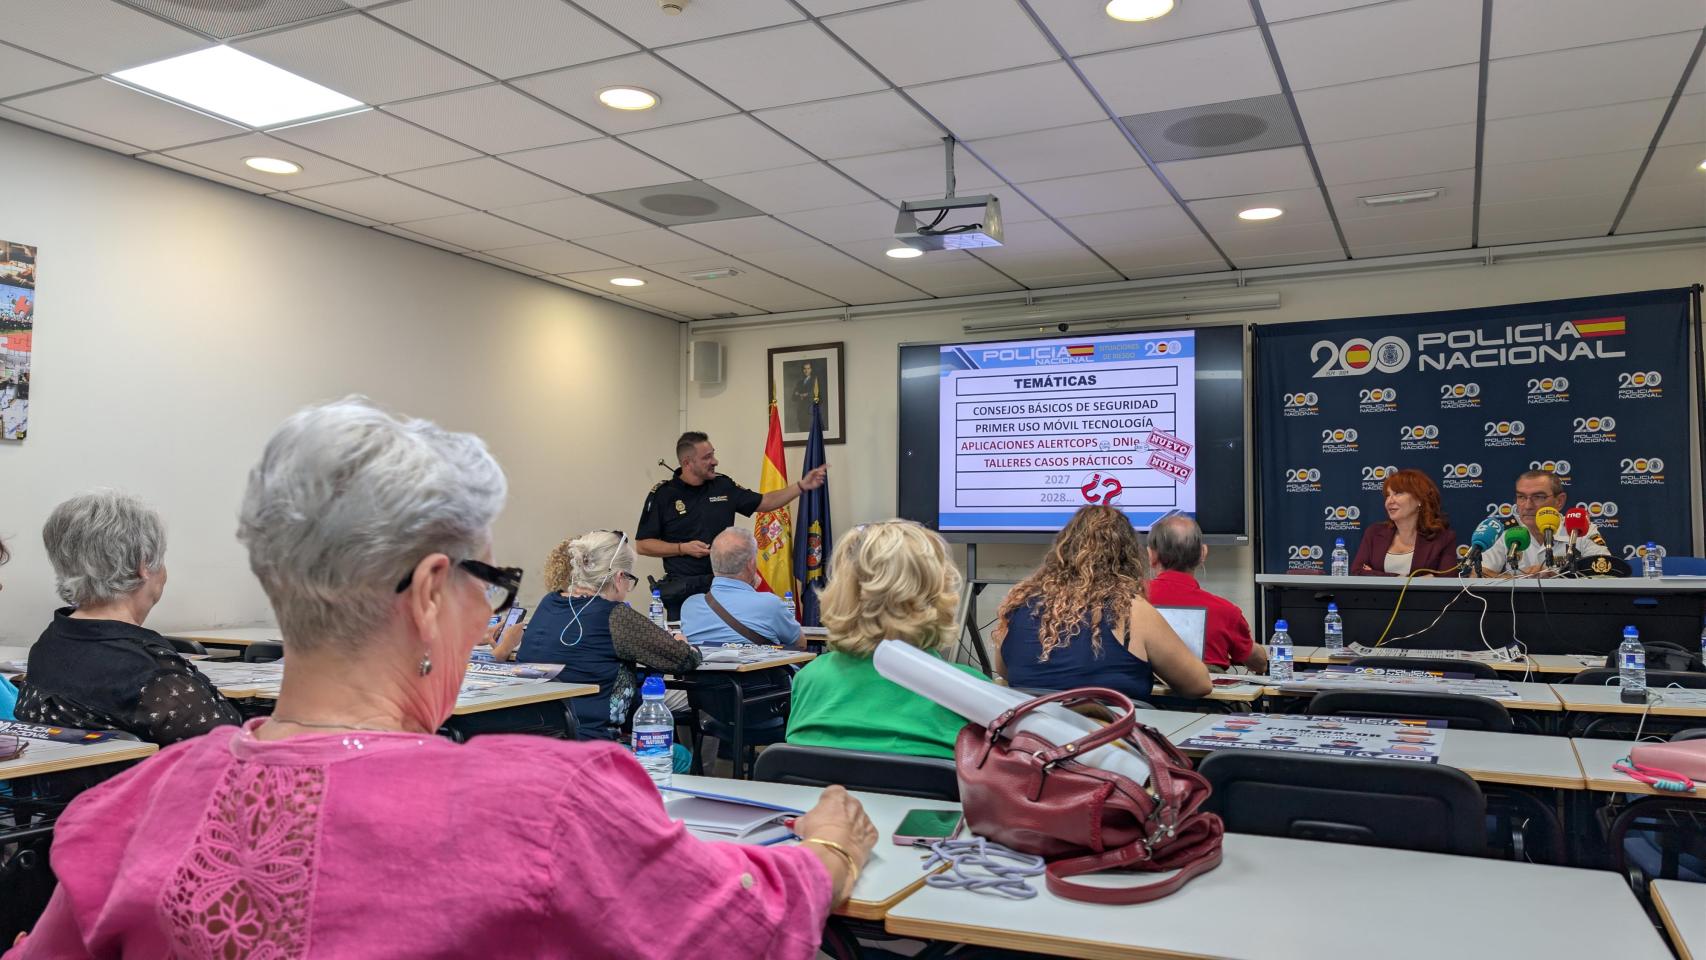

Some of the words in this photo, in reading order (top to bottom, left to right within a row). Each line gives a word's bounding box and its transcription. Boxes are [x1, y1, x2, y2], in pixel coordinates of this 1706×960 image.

[1035, 355, 1094, 366] NACIONAL
[1419, 340, 1626, 372] NACIONAL
[1014, 374, 1097, 389] TEMÁTICAS
[973, 405, 1025, 416] CONSEJOS
[1028, 402, 1073, 414] BÁSICOS
[1076, 402, 1090, 412] DE
[1093, 399, 1158, 411] SEGURIDAD
[976, 423, 1015, 433] PRIMER
[1018, 422, 1040, 432] USO
[1043, 419, 1079, 431] MÓVIL
[1083, 416, 1153, 429] TECNOLOGÍA
[961, 440, 1034, 451] APLICACIONES
[1037, 438, 1098, 449] ALERTCOPS
[1151, 434, 1188, 454] NUEVO
[984, 458, 1031, 468] TALLERES
[1034, 457, 1069, 467] CASOS
[1072, 453, 1133, 466] PRÁCTICOS
[1151, 457, 1188, 477] NUEVO
[1044, 475, 1070, 485] 2027
